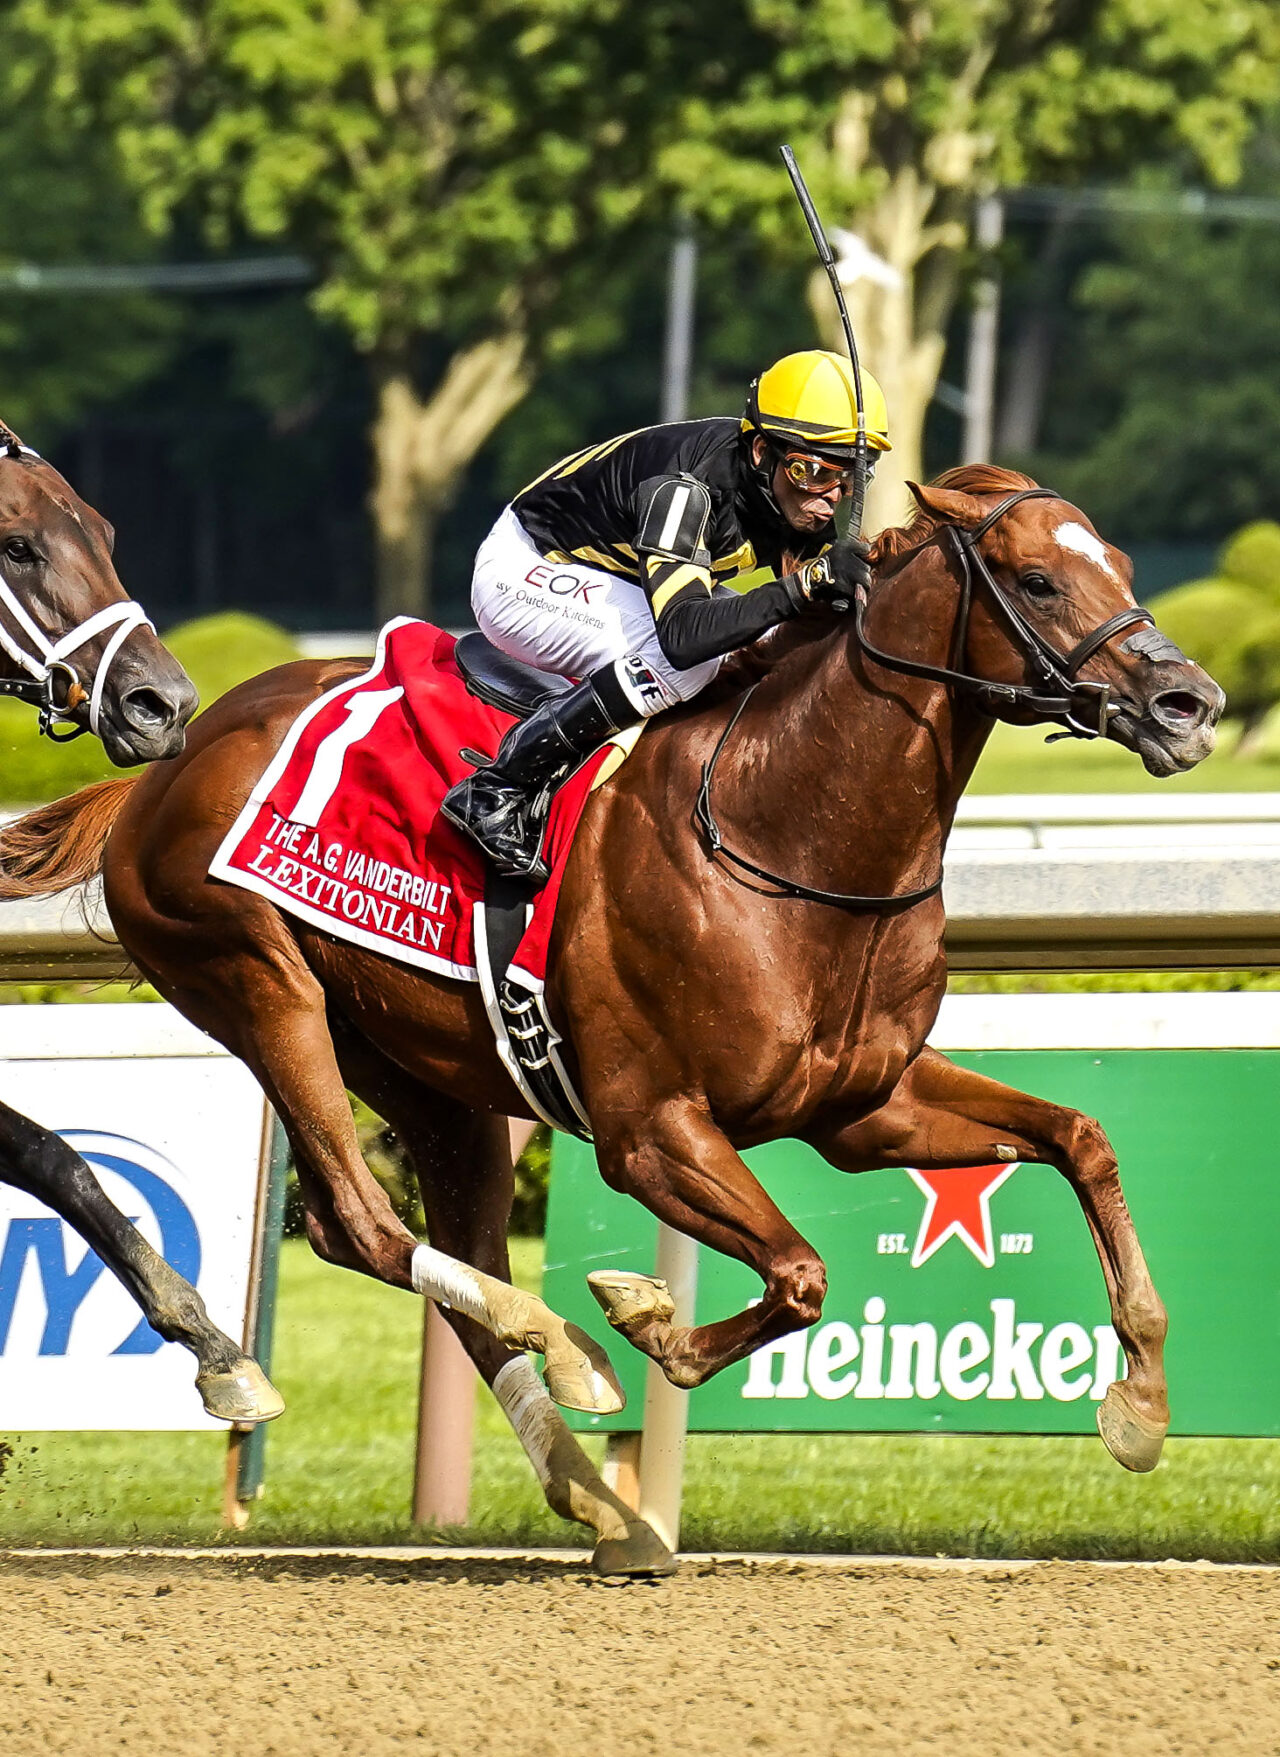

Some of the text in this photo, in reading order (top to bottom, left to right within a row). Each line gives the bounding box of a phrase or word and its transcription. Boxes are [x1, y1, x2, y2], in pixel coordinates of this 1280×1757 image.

[658, 485, 691, 551] 1
[516, 589, 559, 614] Outdoor
[562, 605, 606, 629] Kitchens
[524, 565, 604, 604] EOK
[288, 685, 405, 827] 1
[247, 844, 446, 951] LEXITONIAN
[265, 813, 307, 853] THE
[342, 850, 452, 916] VANDERBILT
[877, 1233, 1034, 1254] EST. 1873
